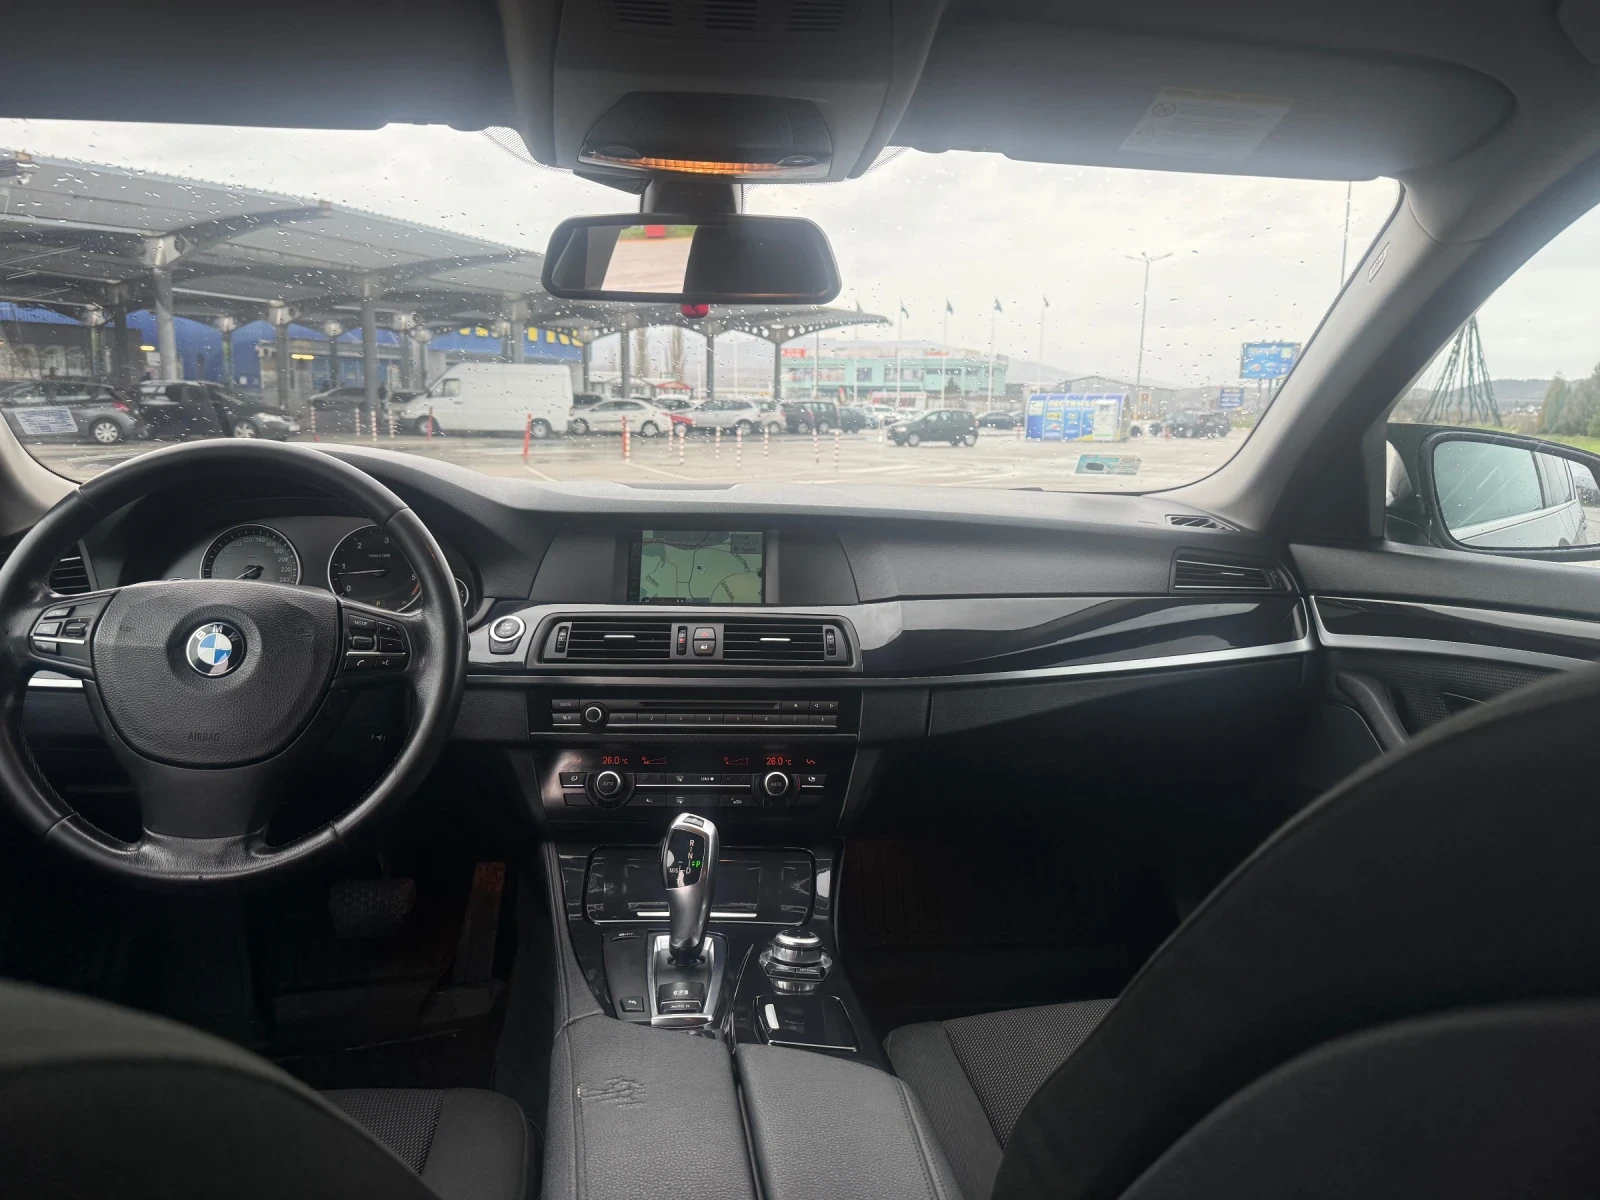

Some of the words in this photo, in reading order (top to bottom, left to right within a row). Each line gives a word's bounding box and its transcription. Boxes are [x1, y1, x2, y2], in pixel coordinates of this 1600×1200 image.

[383, 536, 390, 544] 3
[411, 573, 417, 581] 5
[195, 624, 240, 642] BMW
[187, 731, 220, 742] AIRBAG
[602, 756, 620, 765] 26.0
[766, 756, 784, 766] 26.0
[689, 839, 695, 847] R
[687, 852, 694, 860] N
[695, 860, 701, 868] P
[685, 866, 692, 875] D
